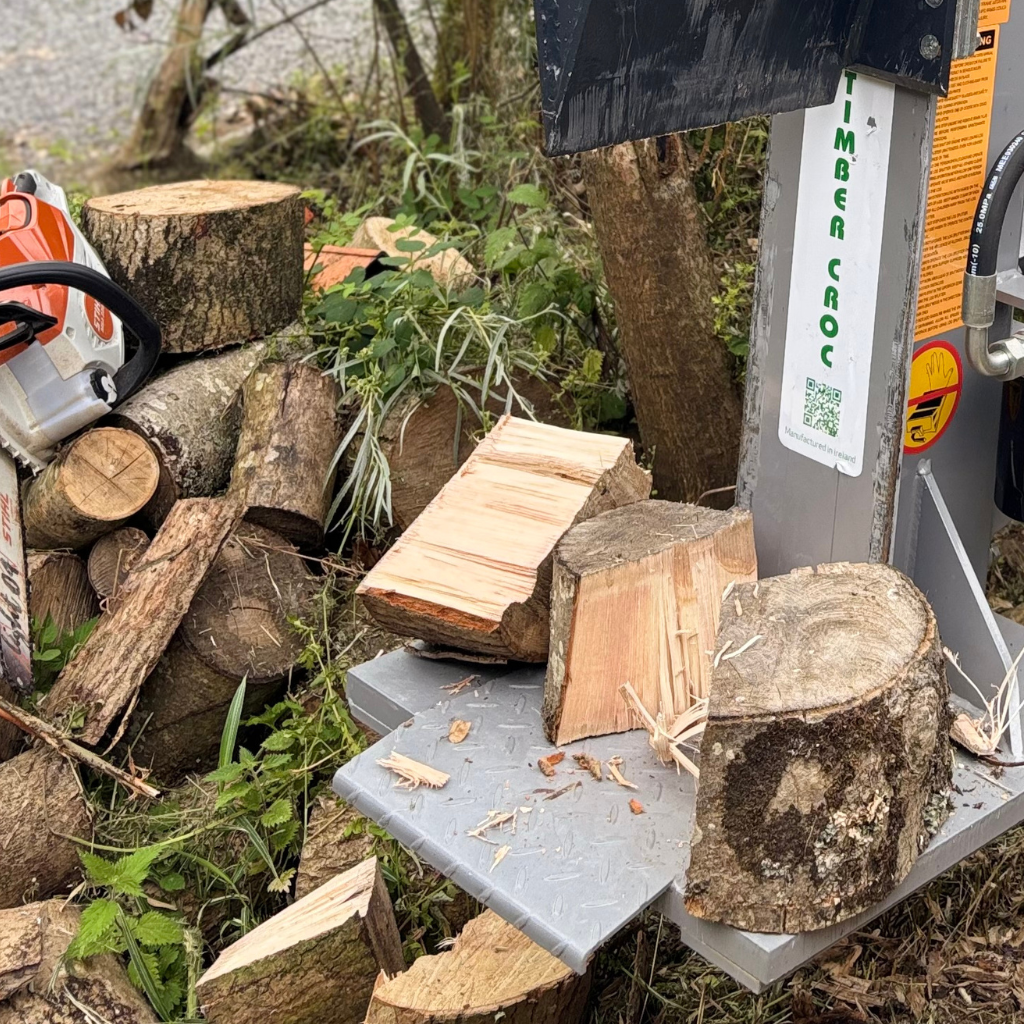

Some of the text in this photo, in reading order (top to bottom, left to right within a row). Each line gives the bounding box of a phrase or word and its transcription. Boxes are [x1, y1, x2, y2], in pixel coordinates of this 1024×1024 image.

[819, 70, 858, 369] TIMBER CROC
[970, 243, 981, 276] m(-10)
[93, 299, 102, 332] STIH
[784, 425, 857, 464] Manufactured in Ireland
[1, 493, 13, 548] STIHL
